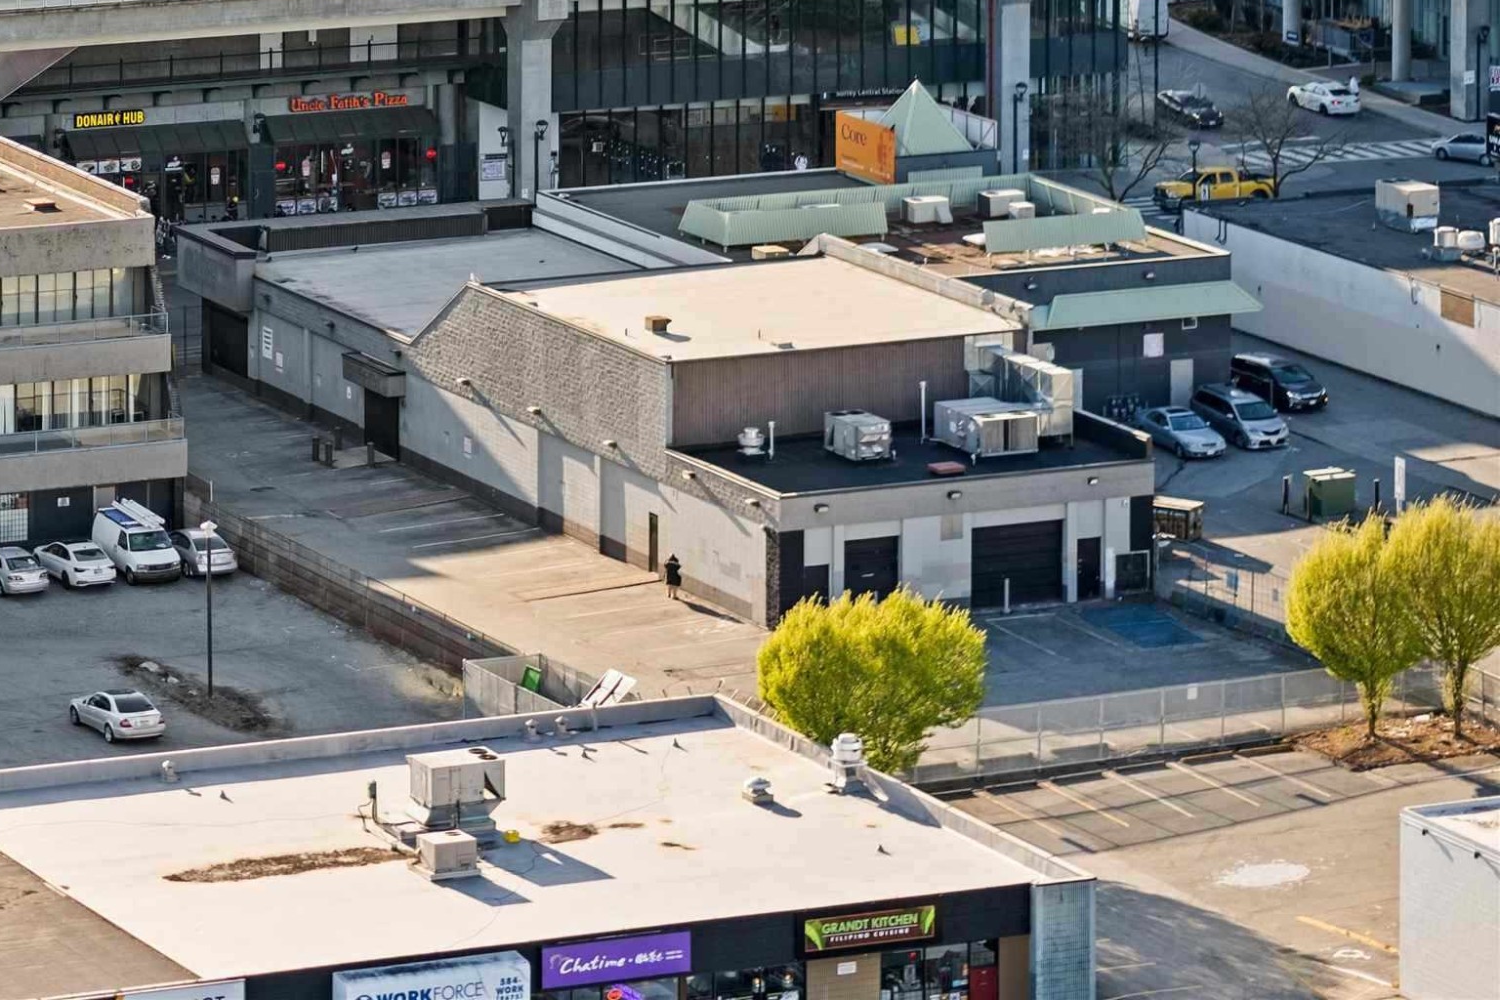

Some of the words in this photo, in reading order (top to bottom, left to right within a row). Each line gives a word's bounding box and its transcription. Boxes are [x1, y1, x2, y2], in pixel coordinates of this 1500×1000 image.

[290, 97, 326, 112] Uncle
[373, 90, 408, 106] Pizza
[76, 113, 114, 128] DONAIR
[123, 111, 144, 124] HUB
[841, 123, 867, 146] Core
[822, 919, 869, 933] GRANDT
[871, 914, 918, 927] KITCHEN
[829, 933, 870, 943] FILIPINO
[873, 928, 910, 937] CUISINE
[560, 955, 626, 974] Chatime
[495, 985, 524, 994] WORK
